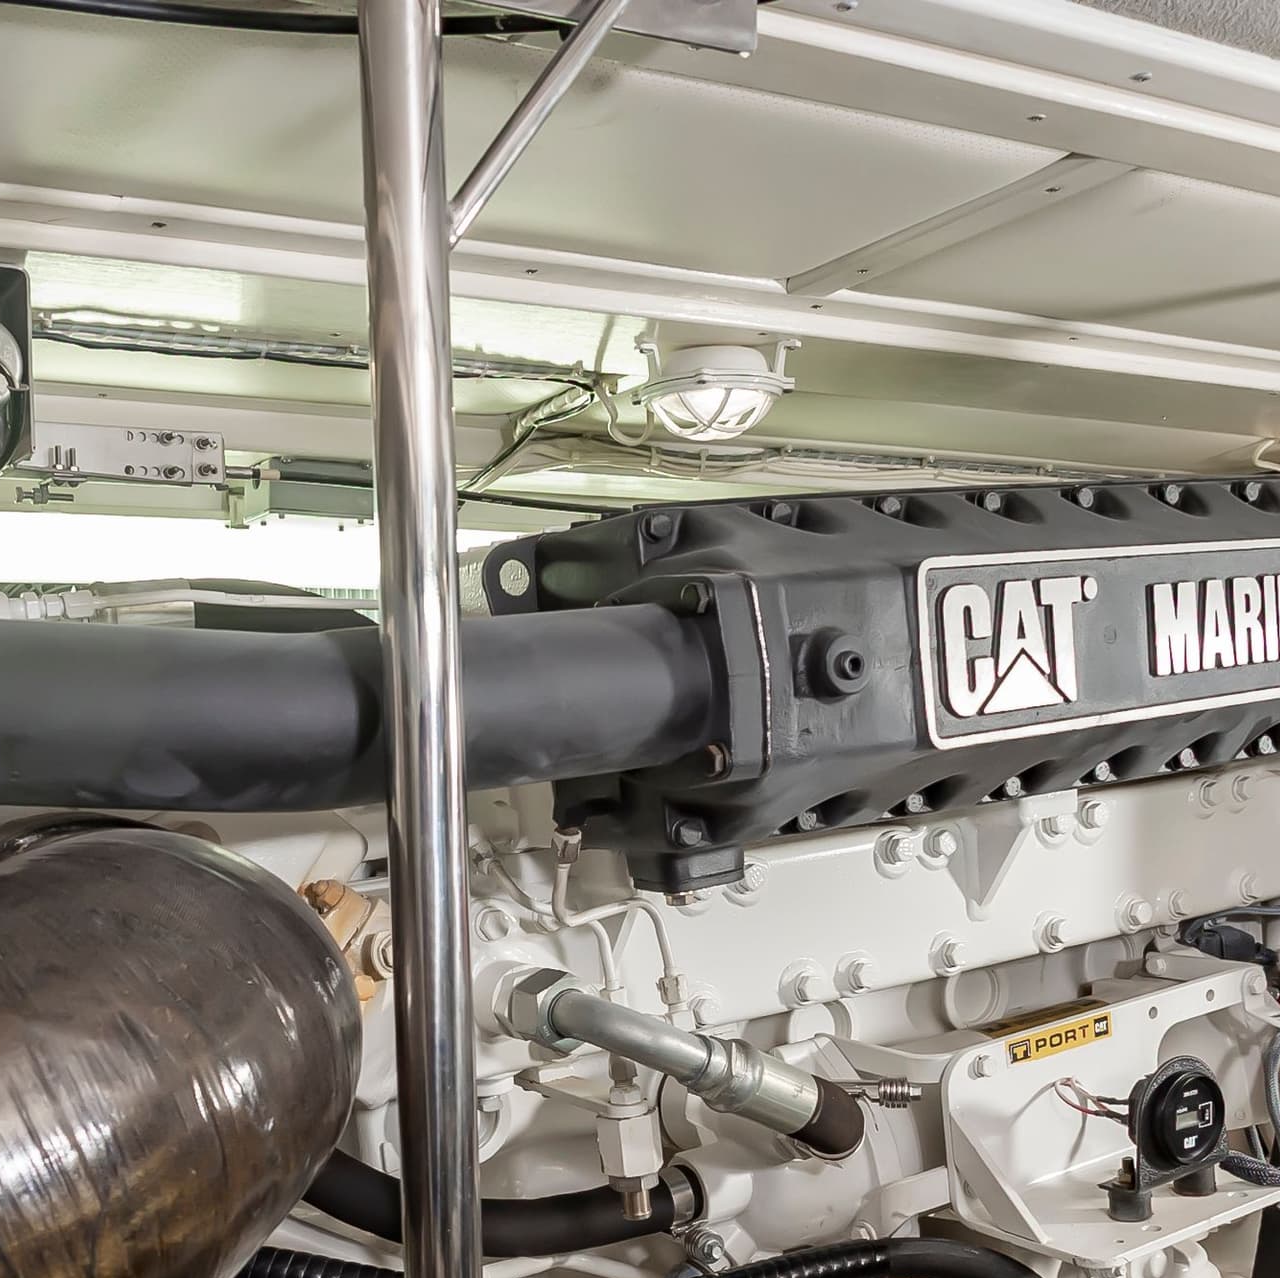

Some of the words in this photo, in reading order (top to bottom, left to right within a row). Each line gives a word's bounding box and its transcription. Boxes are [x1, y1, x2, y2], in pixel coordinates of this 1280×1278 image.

[940, 576, 1083, 718] CAT
[1035, 1024, 1089, 1052] PORT
[1094, 1019, 1108, 1034] CAT
